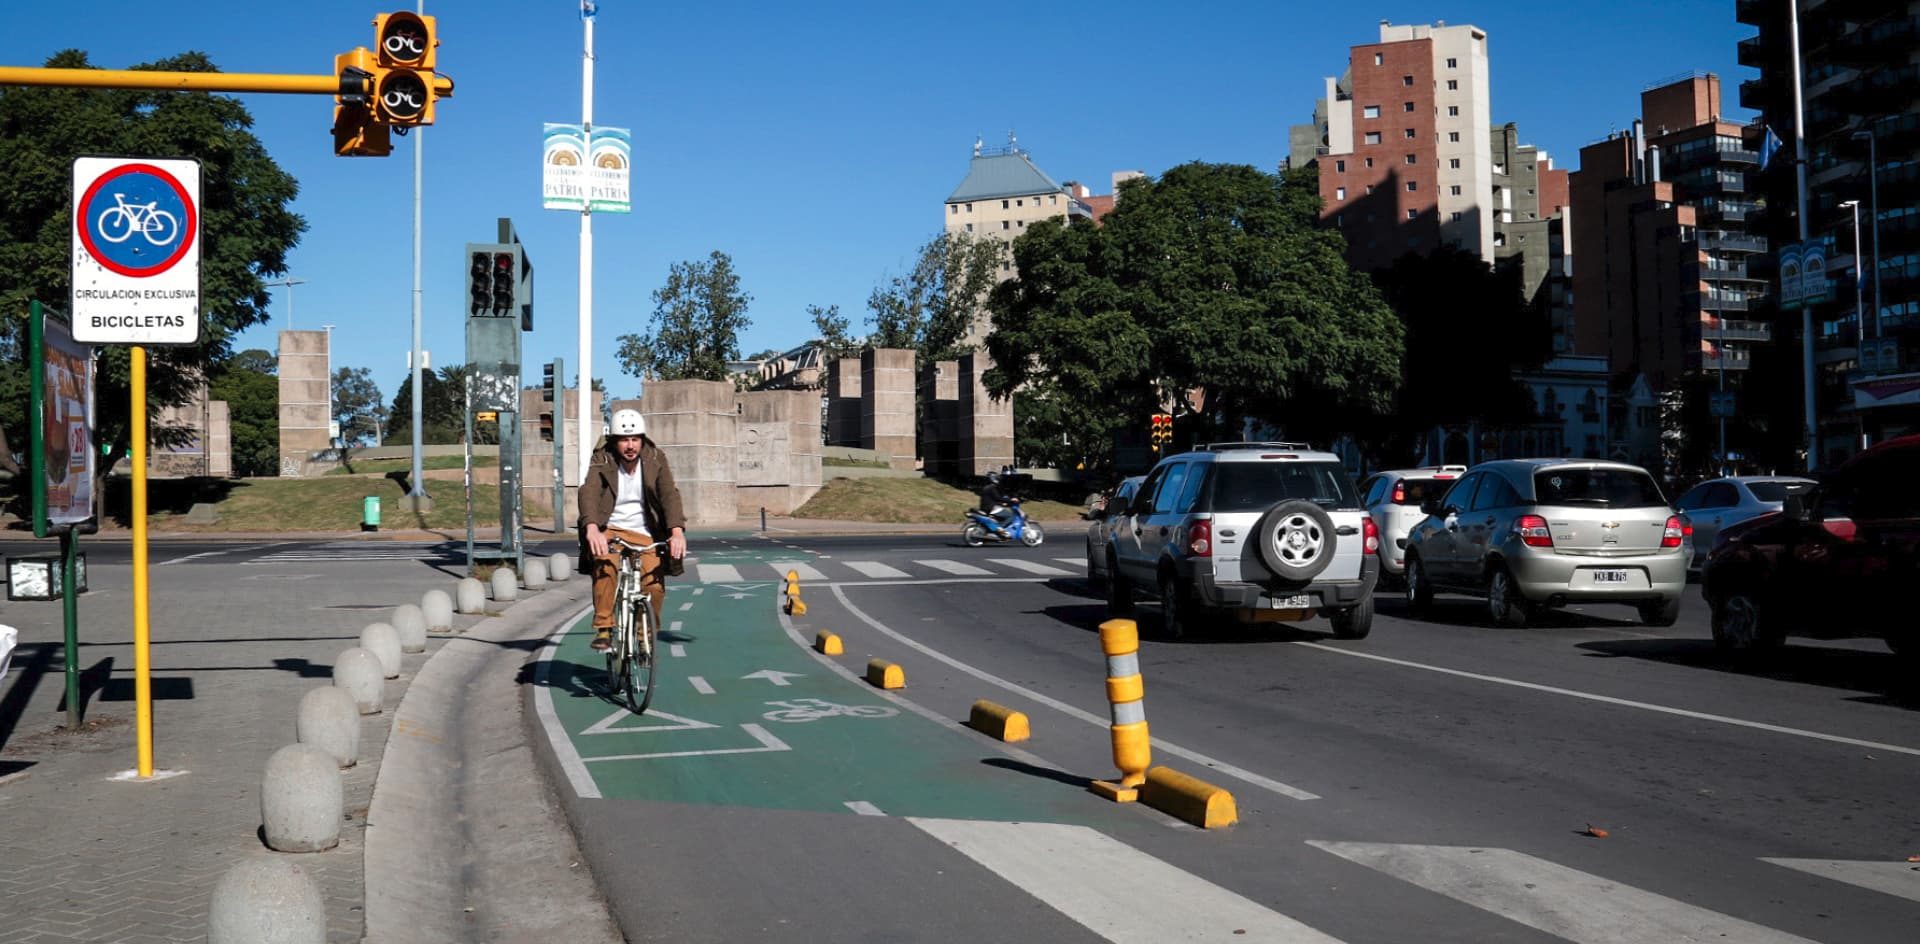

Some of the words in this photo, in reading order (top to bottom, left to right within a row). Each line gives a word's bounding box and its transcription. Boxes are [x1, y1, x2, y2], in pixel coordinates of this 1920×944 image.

[545, 184, 583, 197] PATRIA
[591, 186, 627, 199] PATRIA
[75, 289, 141, 299] CIRCULACION
[144, 289, 196, 299] EXCLUSIVA
[91, 315, 185, 328] BICICLETAS
